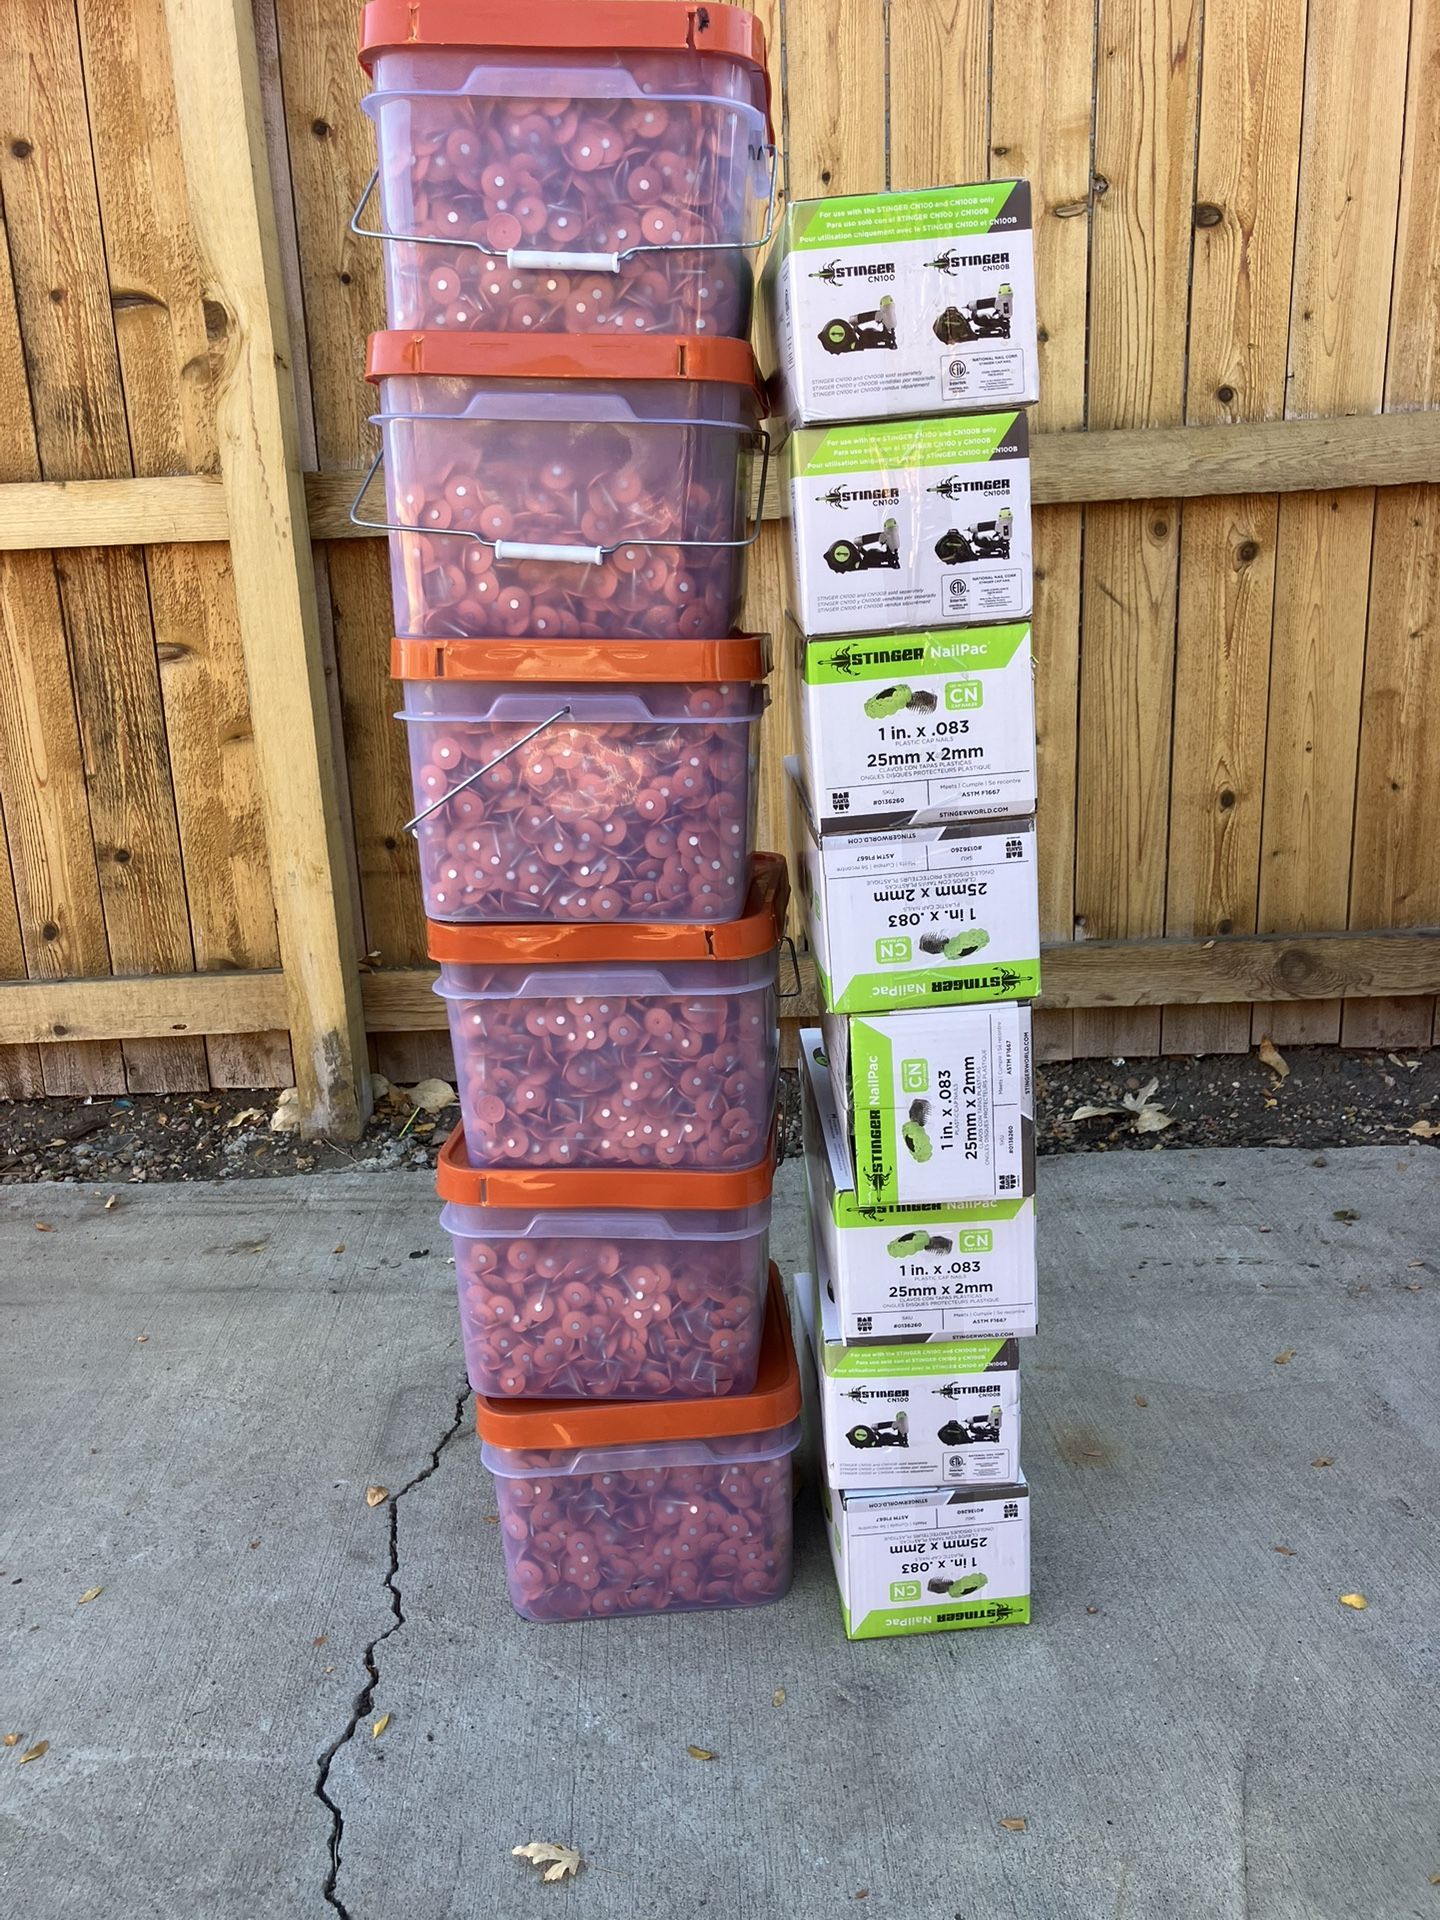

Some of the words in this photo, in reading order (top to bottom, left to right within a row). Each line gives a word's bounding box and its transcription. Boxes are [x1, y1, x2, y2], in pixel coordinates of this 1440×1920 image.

[877, 204, 908, 213] STINGER
[950, 198, 977, 206] CN100B
[980, 196, 995, 204] only
[897, 213, 927, 222] STINGER
[961, 208, 988, 216] CN100B
[818, 232, 852, 241] utilisation
[854, 228, 895, 238] uniquement
[923, 222, 953, 231] STINGER
[956, 220, 978, 228] CN100
[951, 253, 1009, 267] STINGER
[836, 263, 895, 277] STINGER
[868, 274, 895, 283] CN100
[954, 479, 1010, 492] STINGER
[842, 488, 899, 501] STINGER
[852, 648, 924, 665] STINGER
[931, 643, 987, 658] NailPac
[951, 687, 977, 703] CN
[879, 728, 885, 740] 1
[891, 726, 911, 739] in.
[917, 727, 925, 737] x
[932, 721, 969, 736] .083
[868, 750, 920, 767] 25mm
[926, 752, 935, 762] x
[941, 745, 983, 761] 2mm
[914, 767, 956, 776] PROTECTEURS
[958, 764, 991, 772] PLASTIQUE
[873, 797, 904, 805] #0136260
[940, 807, 1008, 817] STINGERWORLD.COM
[848, 833, 916, 844] STINGERWORLD.COM
[874, 889, 915, 904] 2mm
[921, 888, 929, 897] x
[936, 883, 987, 899] 25mm
[888, 912, 924, 927] .083
[931, 911, 939, 921] x
[945, 909, 964, 922] in.
[970, 908, 976, 920] 1
[881, 943, 907, 958] CN
[873, 983, 925, 997] NailPac
[932, 977, 1000, 992] STINGER
[868, 1056, 880, 1104] NailPac
[908, 1064, 922, 1087] CN
[963, 1057, 975, 1094] 2mm
[939, 1070, 951, 1103] .083
[967, 1100, 975, 1108] x
[941, 1122, 952, 1138] in.
[965, 1114, 977, 1159] 25mm
[870, 1110, 882, 1172] STINGER
[964, 1236, 988, 1247] CN
[900, 1265, 905, 1275] 1
[912, 1264, 928, 1275] in.
[934, 1266, 941, 1274] x
[947, 1262, 980, 1273] .083
[889, 1285, 936, 1297] 25mm
[942, 1287, 949, 1295] x
[956, 1282, 992, 1294] 2mm
[862, 1390, 909, 1398] STINGER
[953, 1385, 1000, 1393] STINGER
[869, 1499, 928, 1508] STINGERWORLD.COM
[890, 1543, 925, 1555] 2mm
[931, 1542, 938, 1550] x
[943, 1537, 987, 1551] 25mm
[902, 1561, 933, 1573] .083
[938, 1560, 945, 1568] x
[951, 1558, 966, 1569] in.
[972, 1557, 977, 1567] 1
[895, 1585, 916, 1597] CN
[886, 1616, 931, 1627] NailPac
[937, 1609, 996, 1622] STINGER
